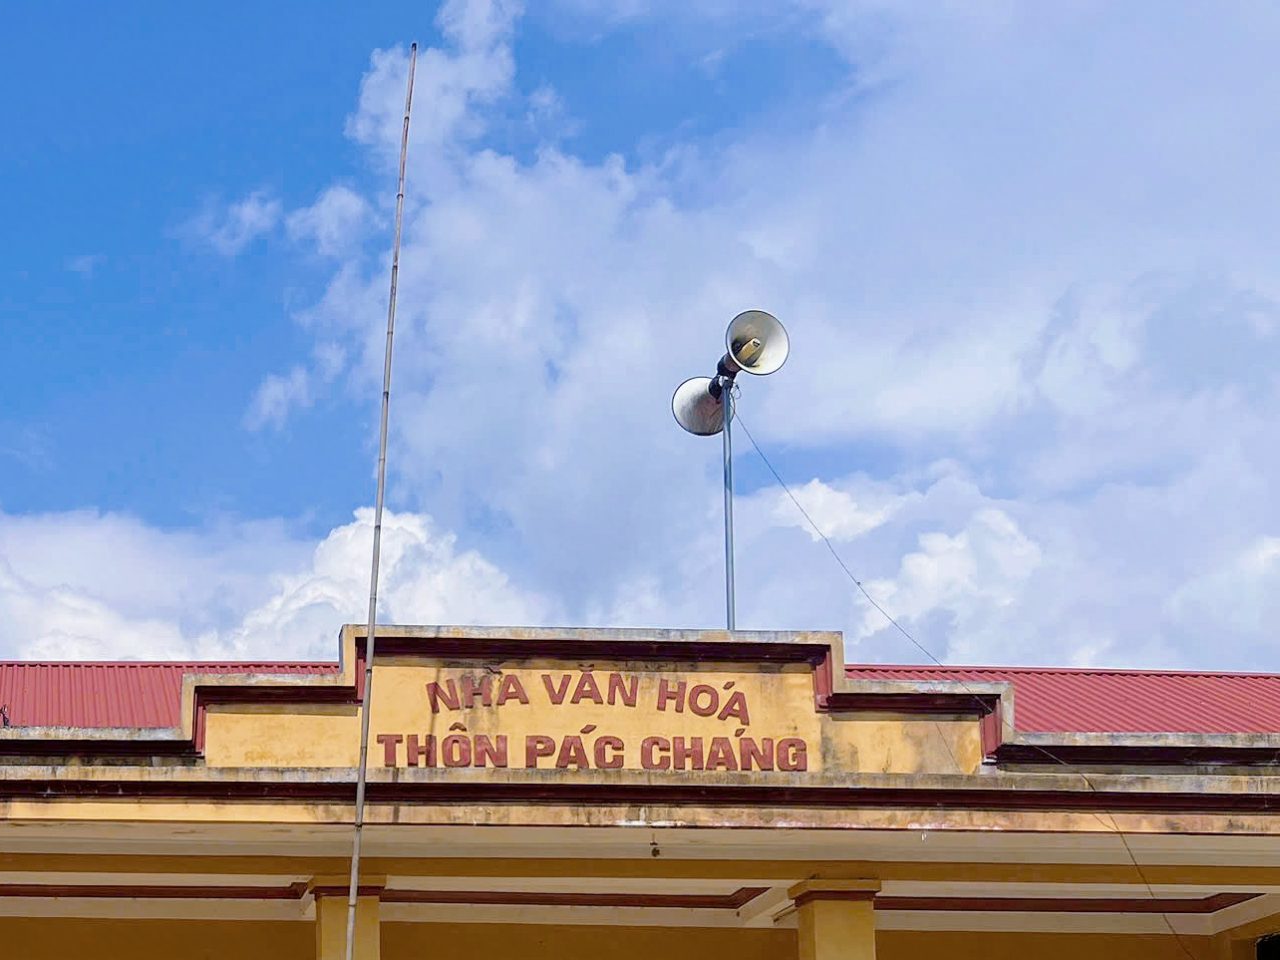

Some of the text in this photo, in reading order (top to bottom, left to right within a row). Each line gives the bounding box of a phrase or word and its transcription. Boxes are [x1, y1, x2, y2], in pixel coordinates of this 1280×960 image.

[541, 663, 638, 708] VĂN
[657, 679, 750, 726] HOÁ
[376, 721, 808, 772] THÔN PÁC CHÁNG
